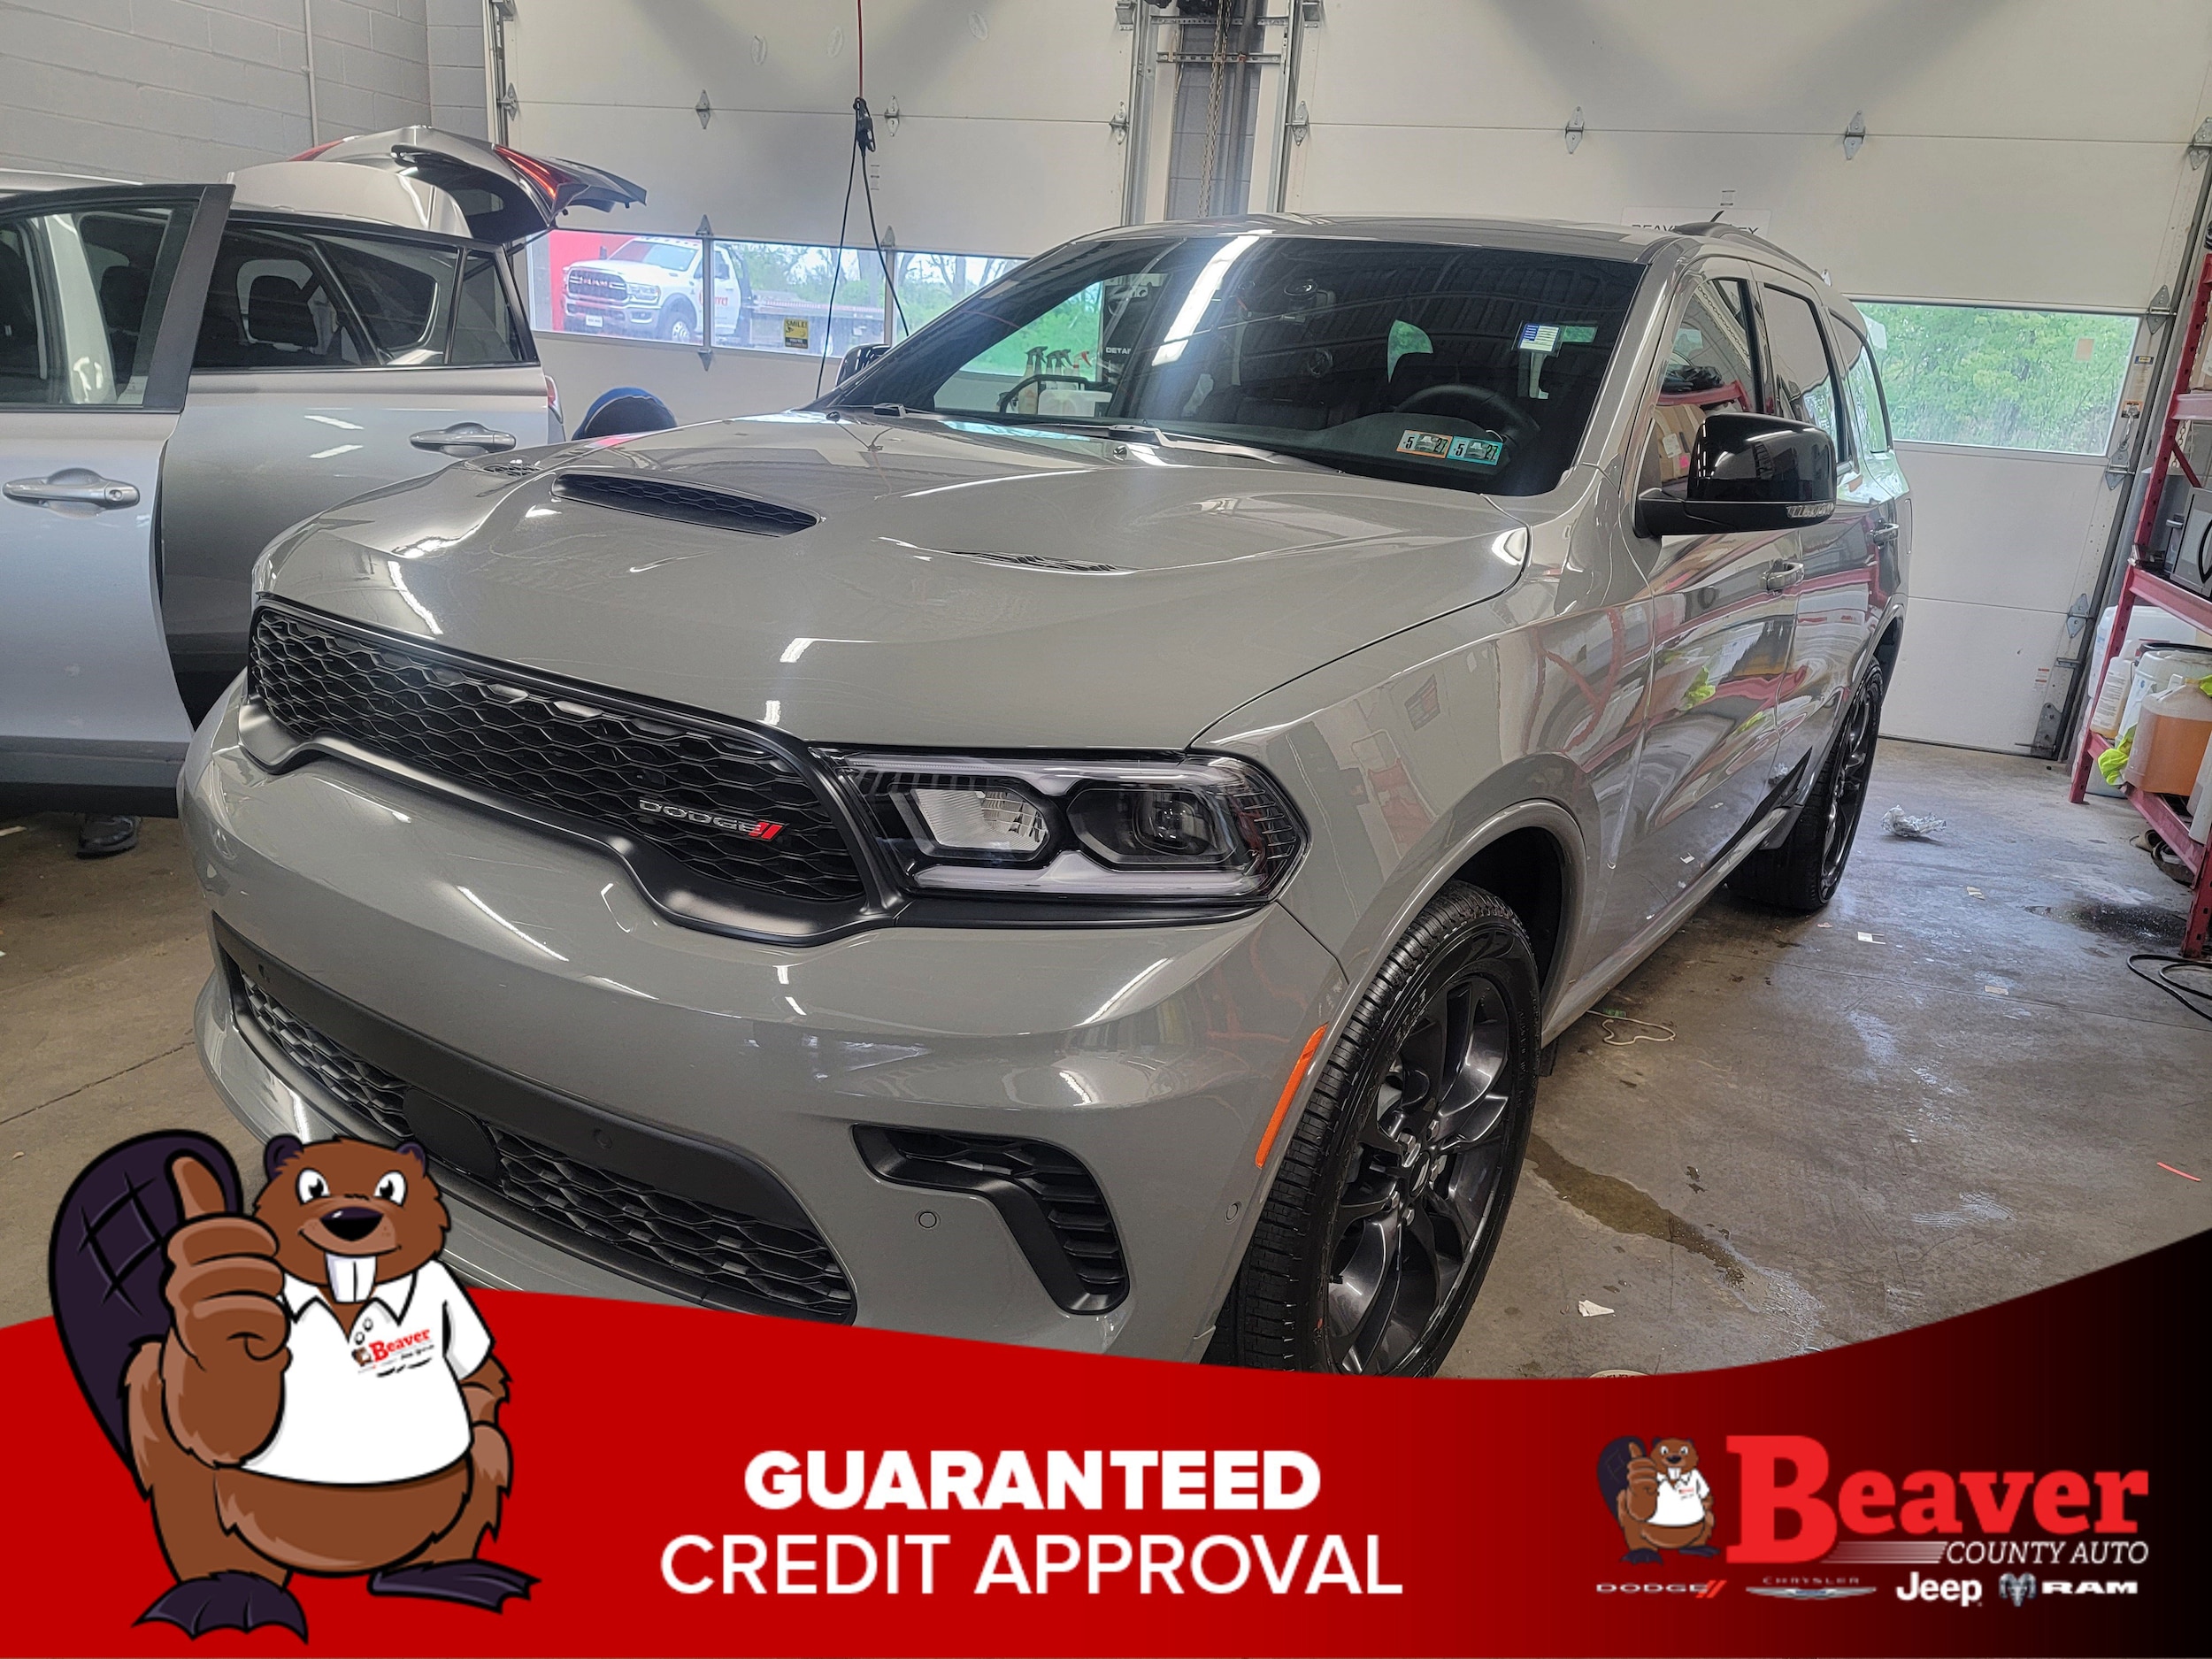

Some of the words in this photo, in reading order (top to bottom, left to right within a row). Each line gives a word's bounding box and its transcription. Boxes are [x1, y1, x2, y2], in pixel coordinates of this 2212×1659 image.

[1405, 437, 1415, 449] 5
[1433, 437, 1448, 454] 27
[1455, 443, 1465, 457] 5
[1484, 444, 1499, 460] 27
[639, 799, 763, 835] DODGE
